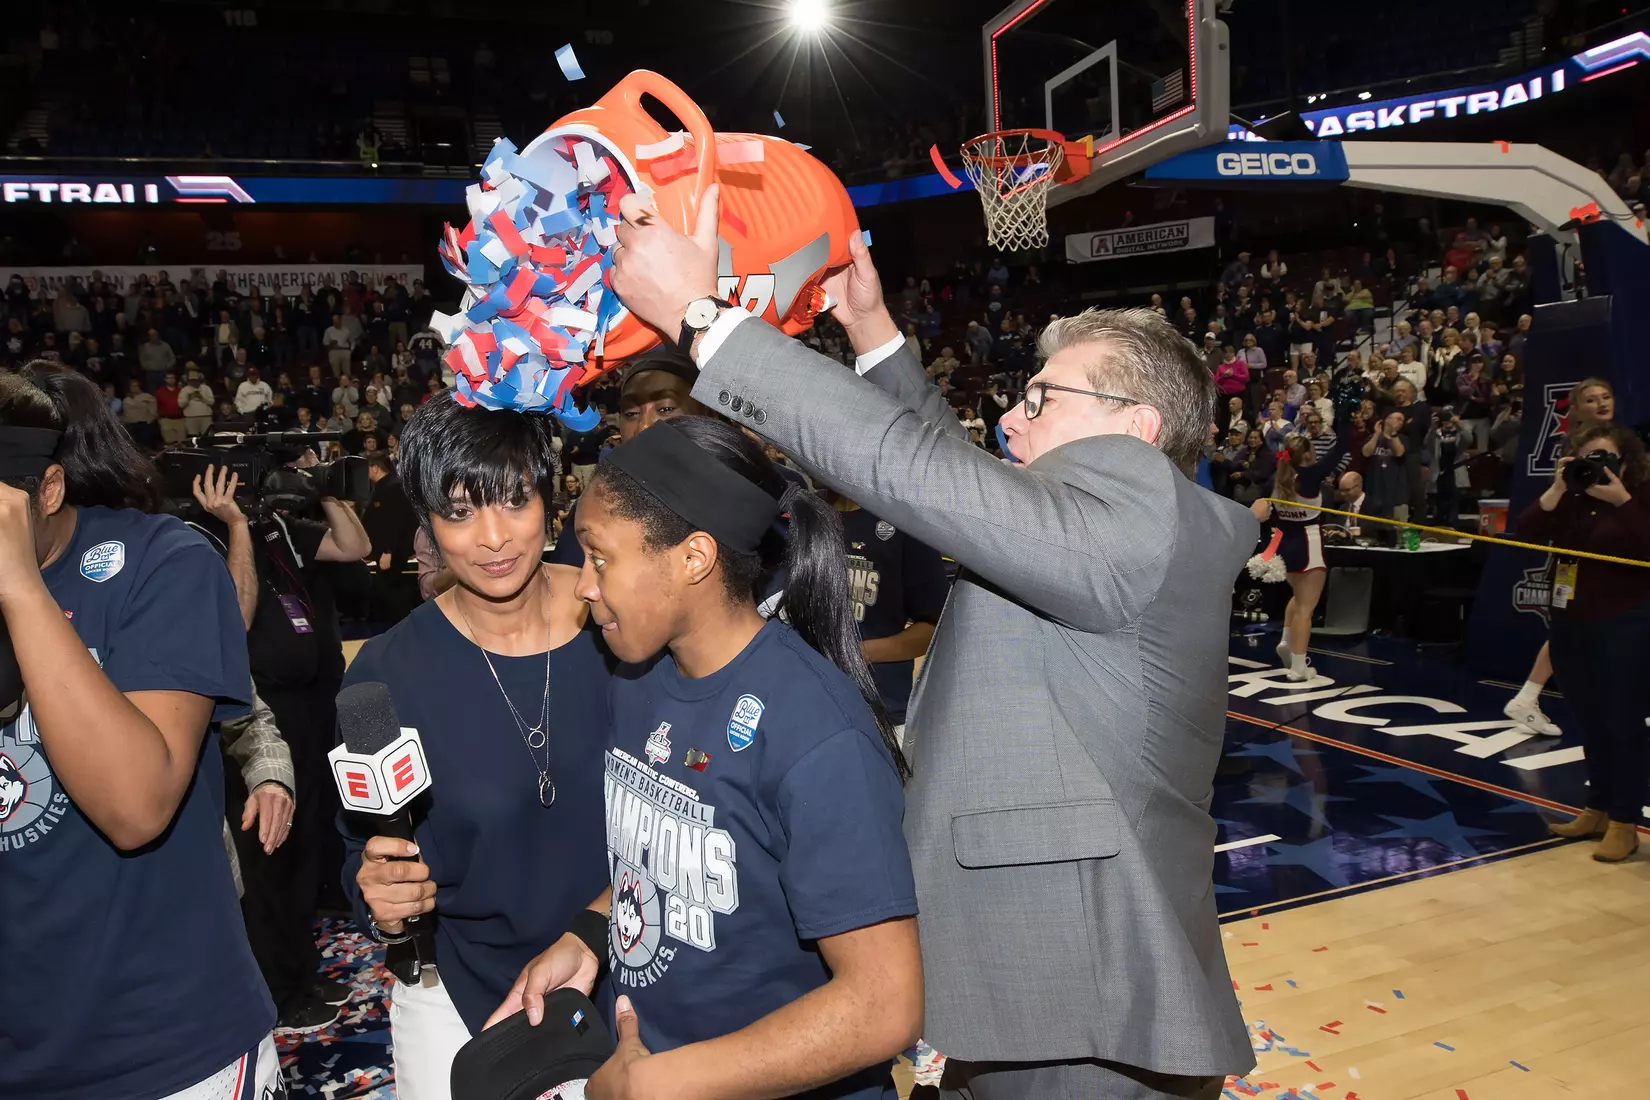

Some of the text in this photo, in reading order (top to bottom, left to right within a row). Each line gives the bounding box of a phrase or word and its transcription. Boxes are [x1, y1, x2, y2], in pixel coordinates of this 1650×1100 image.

[1216, 153, 1317, 176] GEICO
[206, 231, 242, 251] 25
[1115, 226, 1186, 246] AMERICAN
[86, 545, 119, 563] Blue
[735, 700, 760, 718] Blue
[730, 721, 753, 737] OFFICIAL
[638, 776, 708, 823] BASKETBALL
[604, 770, 740, 915] HAMPIONS
[665, 892, 717, 953] 20
[620, 945, 675, 988] HUSKIES
